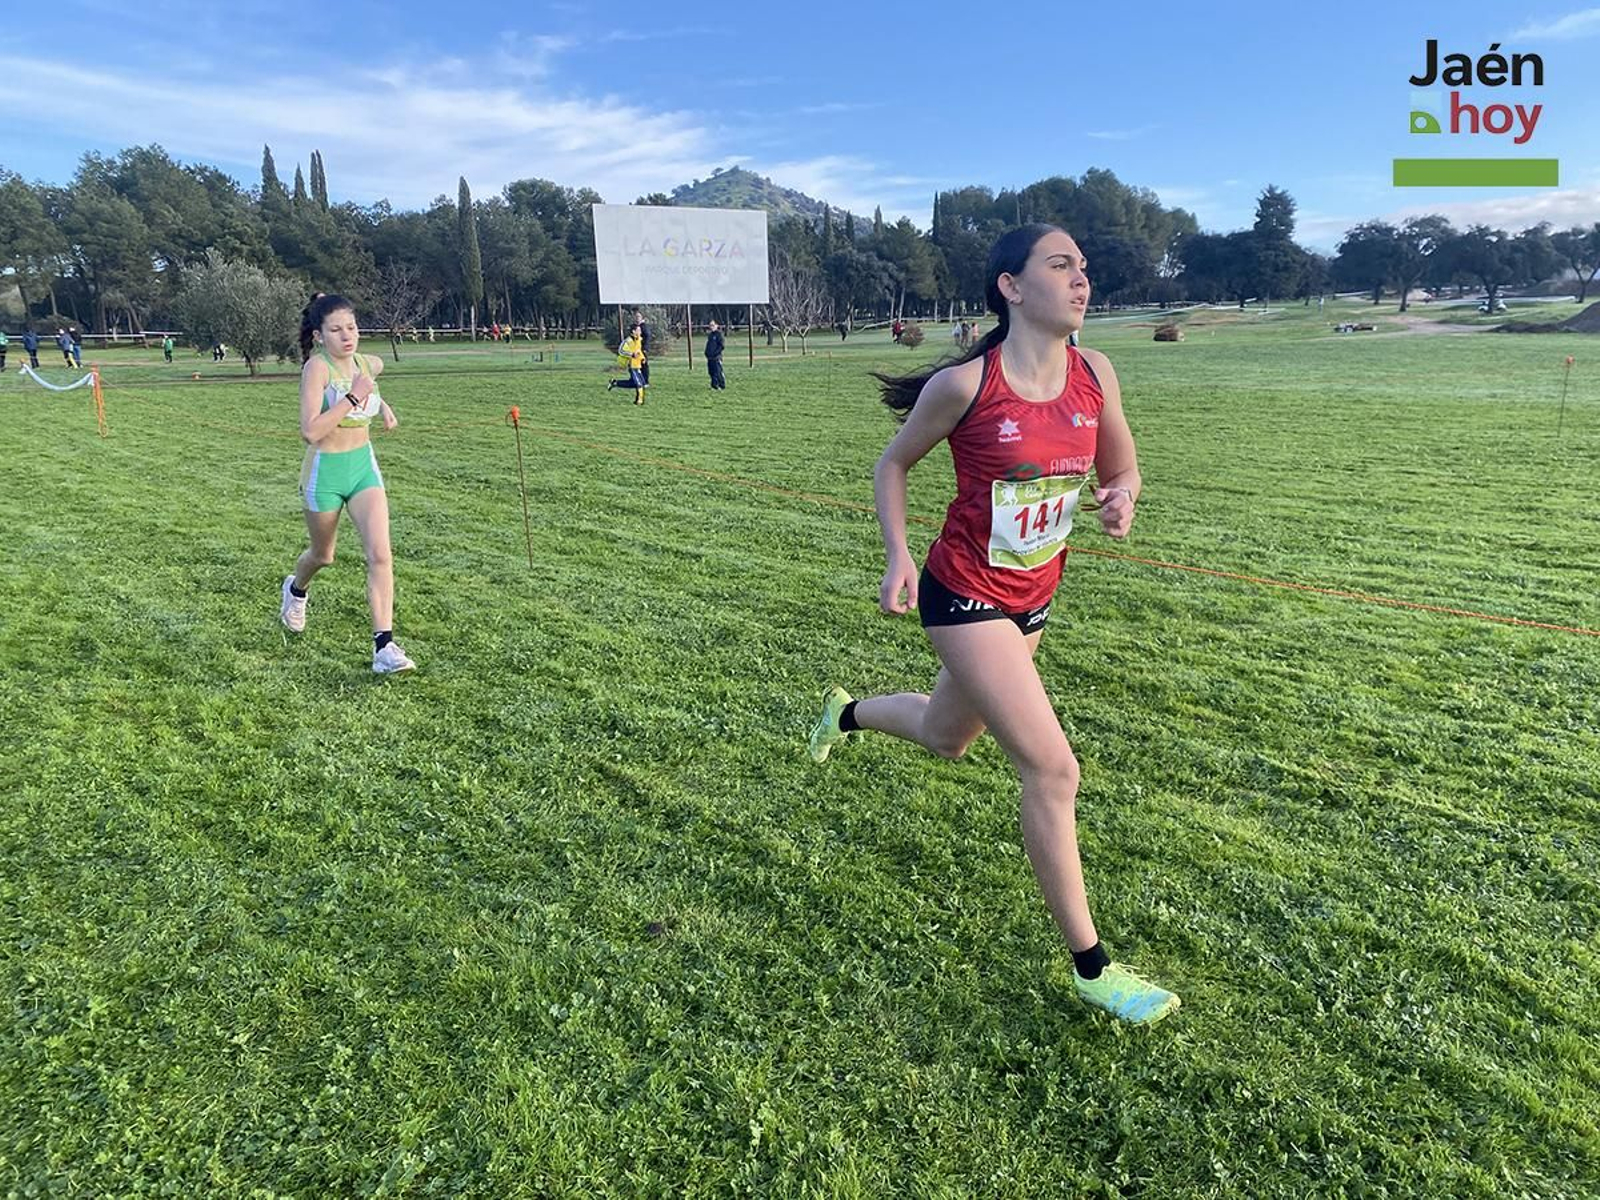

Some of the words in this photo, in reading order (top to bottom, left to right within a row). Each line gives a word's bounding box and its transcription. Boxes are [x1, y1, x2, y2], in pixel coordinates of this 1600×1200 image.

[622, 234, 656, 257] LA
[662, 236, 746, 259] GARZA
[1014, 496, 1065, 539] 141
